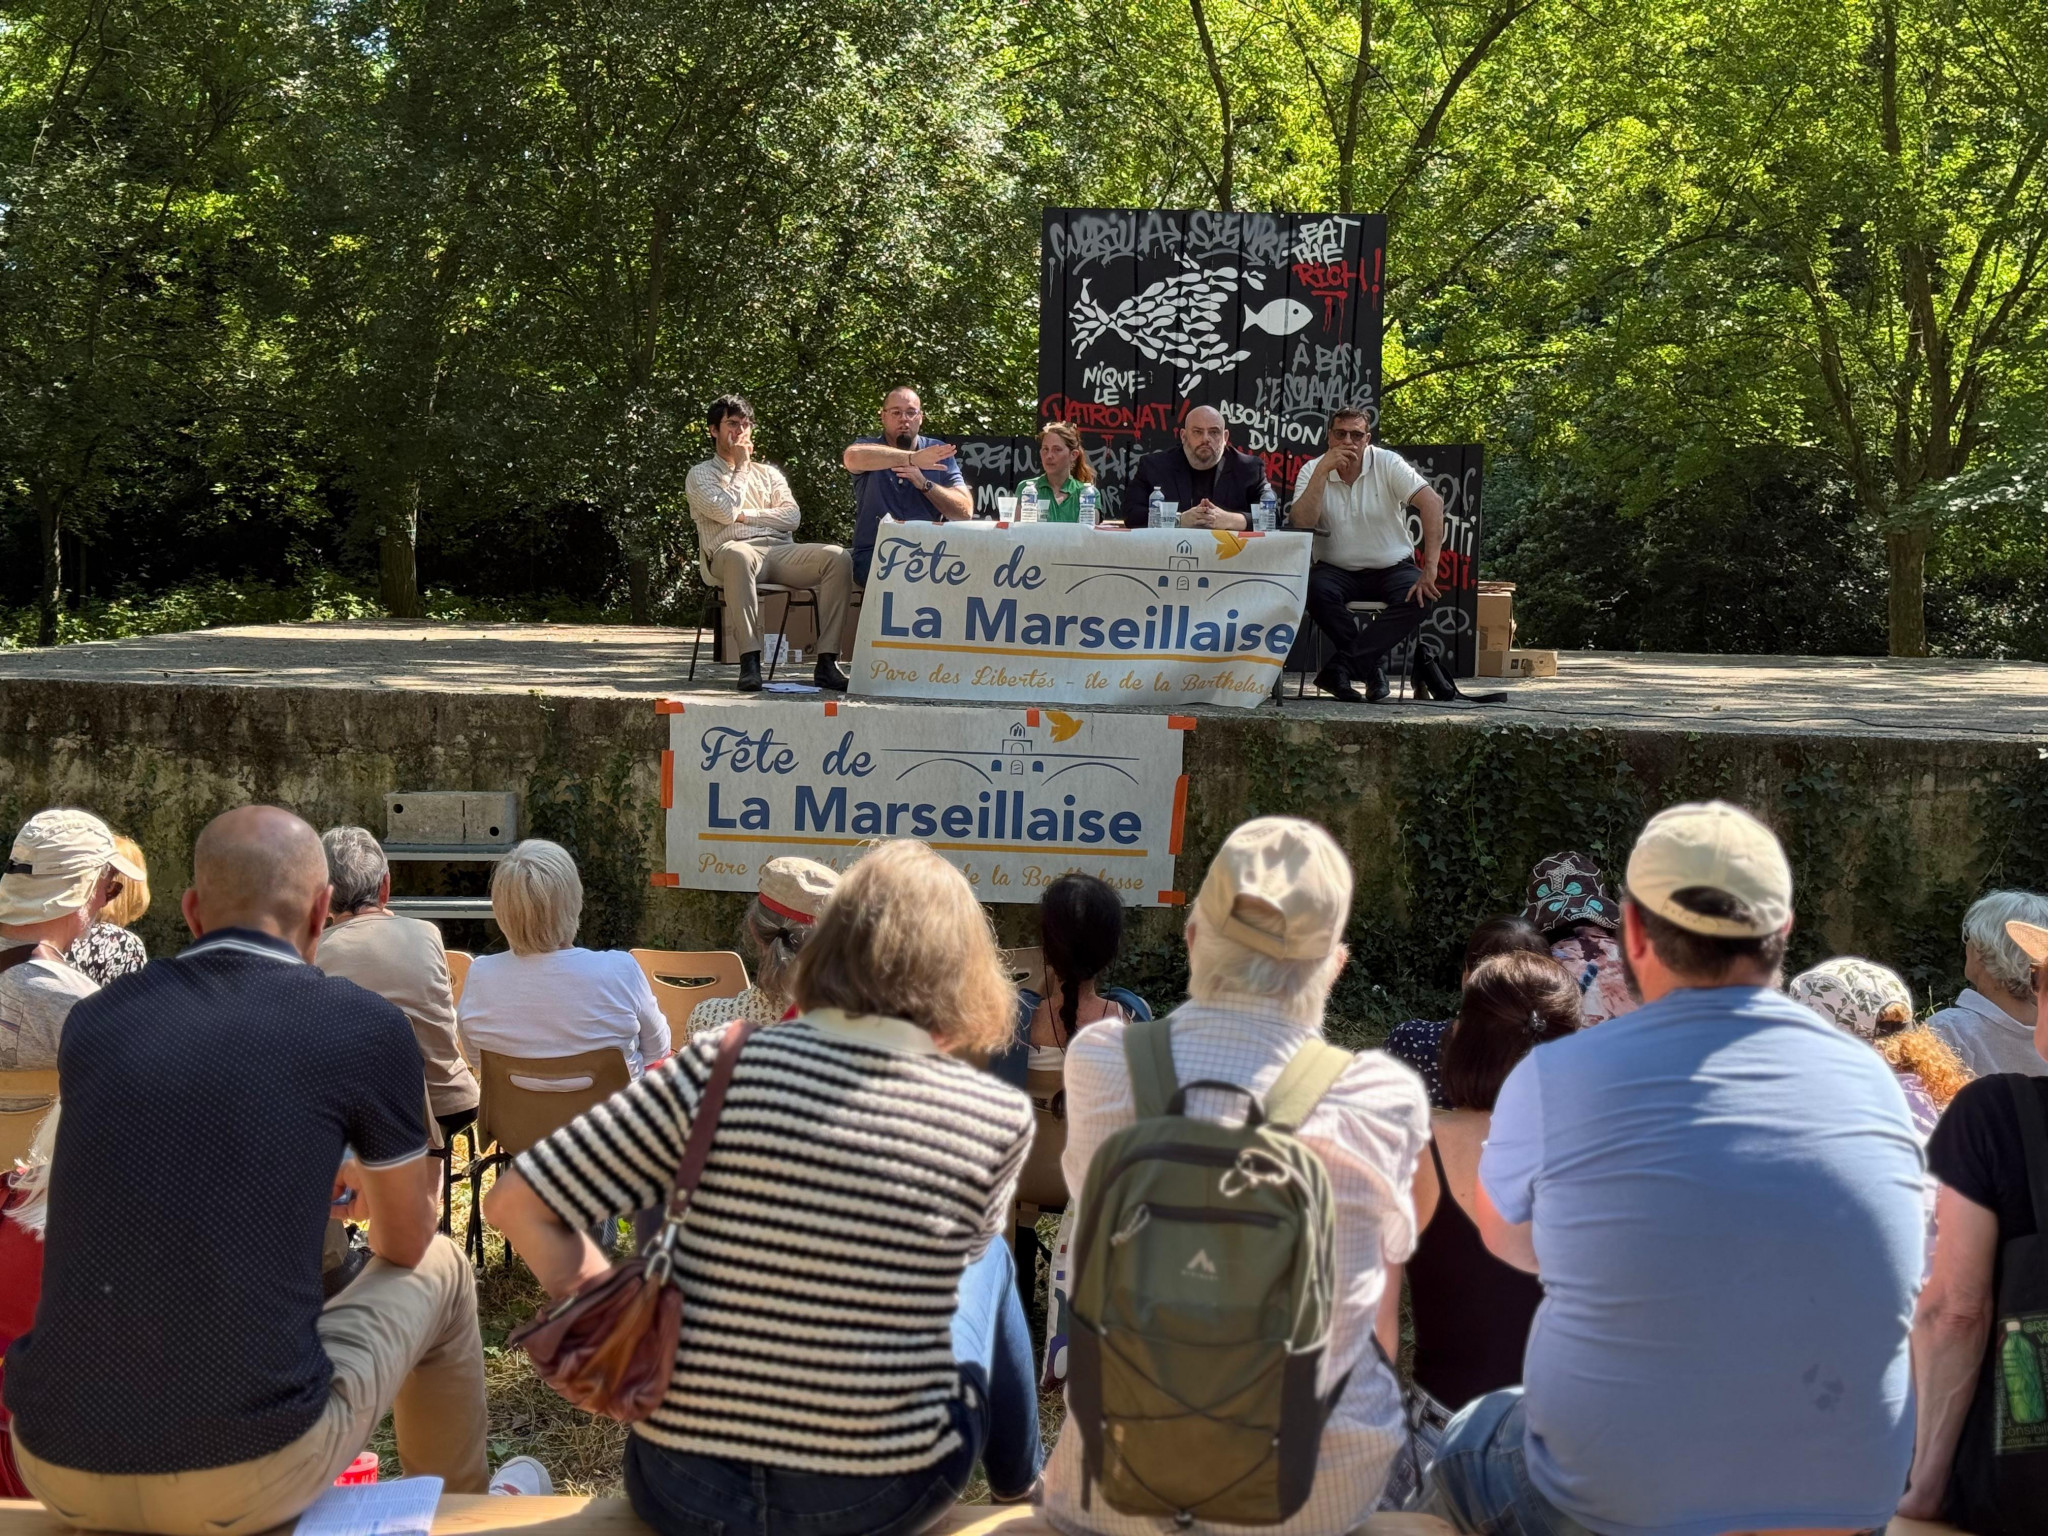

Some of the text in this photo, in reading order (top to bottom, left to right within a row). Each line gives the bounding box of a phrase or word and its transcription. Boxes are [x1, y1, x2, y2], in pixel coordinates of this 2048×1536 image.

[1298, 215, 1361, 251] EAT
[1281, 243, 1344, 265] THE
[1094, 386, 1120, 406] LE
[1248, 428, 1279, 453] DU
[876, 537, 1047, 590] Fête de
[880, 591, 1295, 655] La Marseillaise
[870, 659, 920, 683] Parc
[928, 663, 961, 685] des
[971, 665, 1055, 688] Libertés
[1085, 670, 1109, 690] île
[1119, 670, 1145, 691] de
[1153, 671, 1171, 692] la
[700, 726, 877, 778] Fête de
[708, 782, 1142, 845] La Marseillaise
[698, 852, 749, 876] Parc
[992, 864, 1012, 886] la
